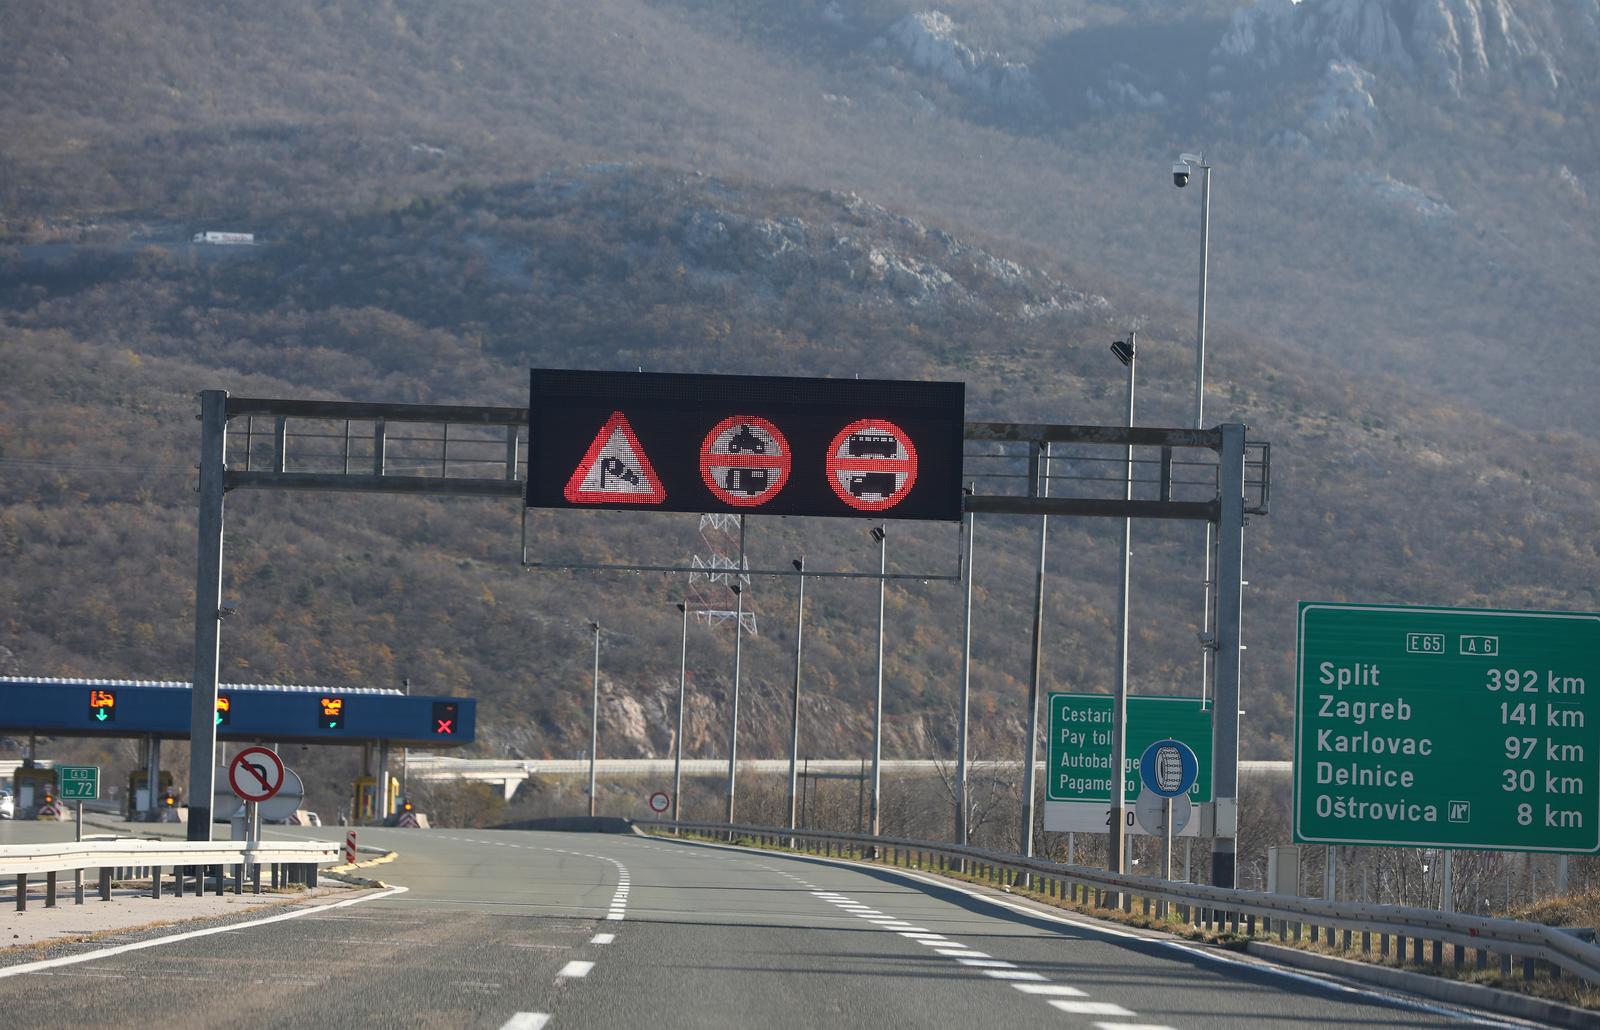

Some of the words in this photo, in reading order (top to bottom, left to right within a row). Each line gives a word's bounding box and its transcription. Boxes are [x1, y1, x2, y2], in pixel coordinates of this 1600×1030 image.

[1411, 636, 1419, 650] E
[1423, 636, 1440, 651] 65
[1468, 639, 1476, 652] A
[1484, 639, 1491, 653] 6
[1319, 661, 1381, 691] Split
[1485, 668, 1539, 693] 392
[1547, 670, 1586, 695] km
[1061, 705, 1128, 723] Cestari
[1318, 694, 1412, 725] Zagreb
[1500, 702, 1537, 726] 141
[1547, 704, 1585, 728] km
[1061, 727, 1086, 749] Pay
[1316, 728, 1433, 757] Karlovac
[1504, 736, 1538, 761] 97
[1546, 737, 1584, 762] km
[1059, 773, 1136, 794] Pagameo
[1316, 761, 1415, 788] Delnice
[1502, 769, 1536, 793] 30
[1545, 770, 1584, 795] km
[65, 787, 75, 795] km
[77, 782, 93, 796] 72
[1105, 810, 1136, 827] 20
[1316, 794, 1438, 822] Oštrovica
[1517, 803, 1533, 826] 8
[1545, 803, 1583, 828] km
